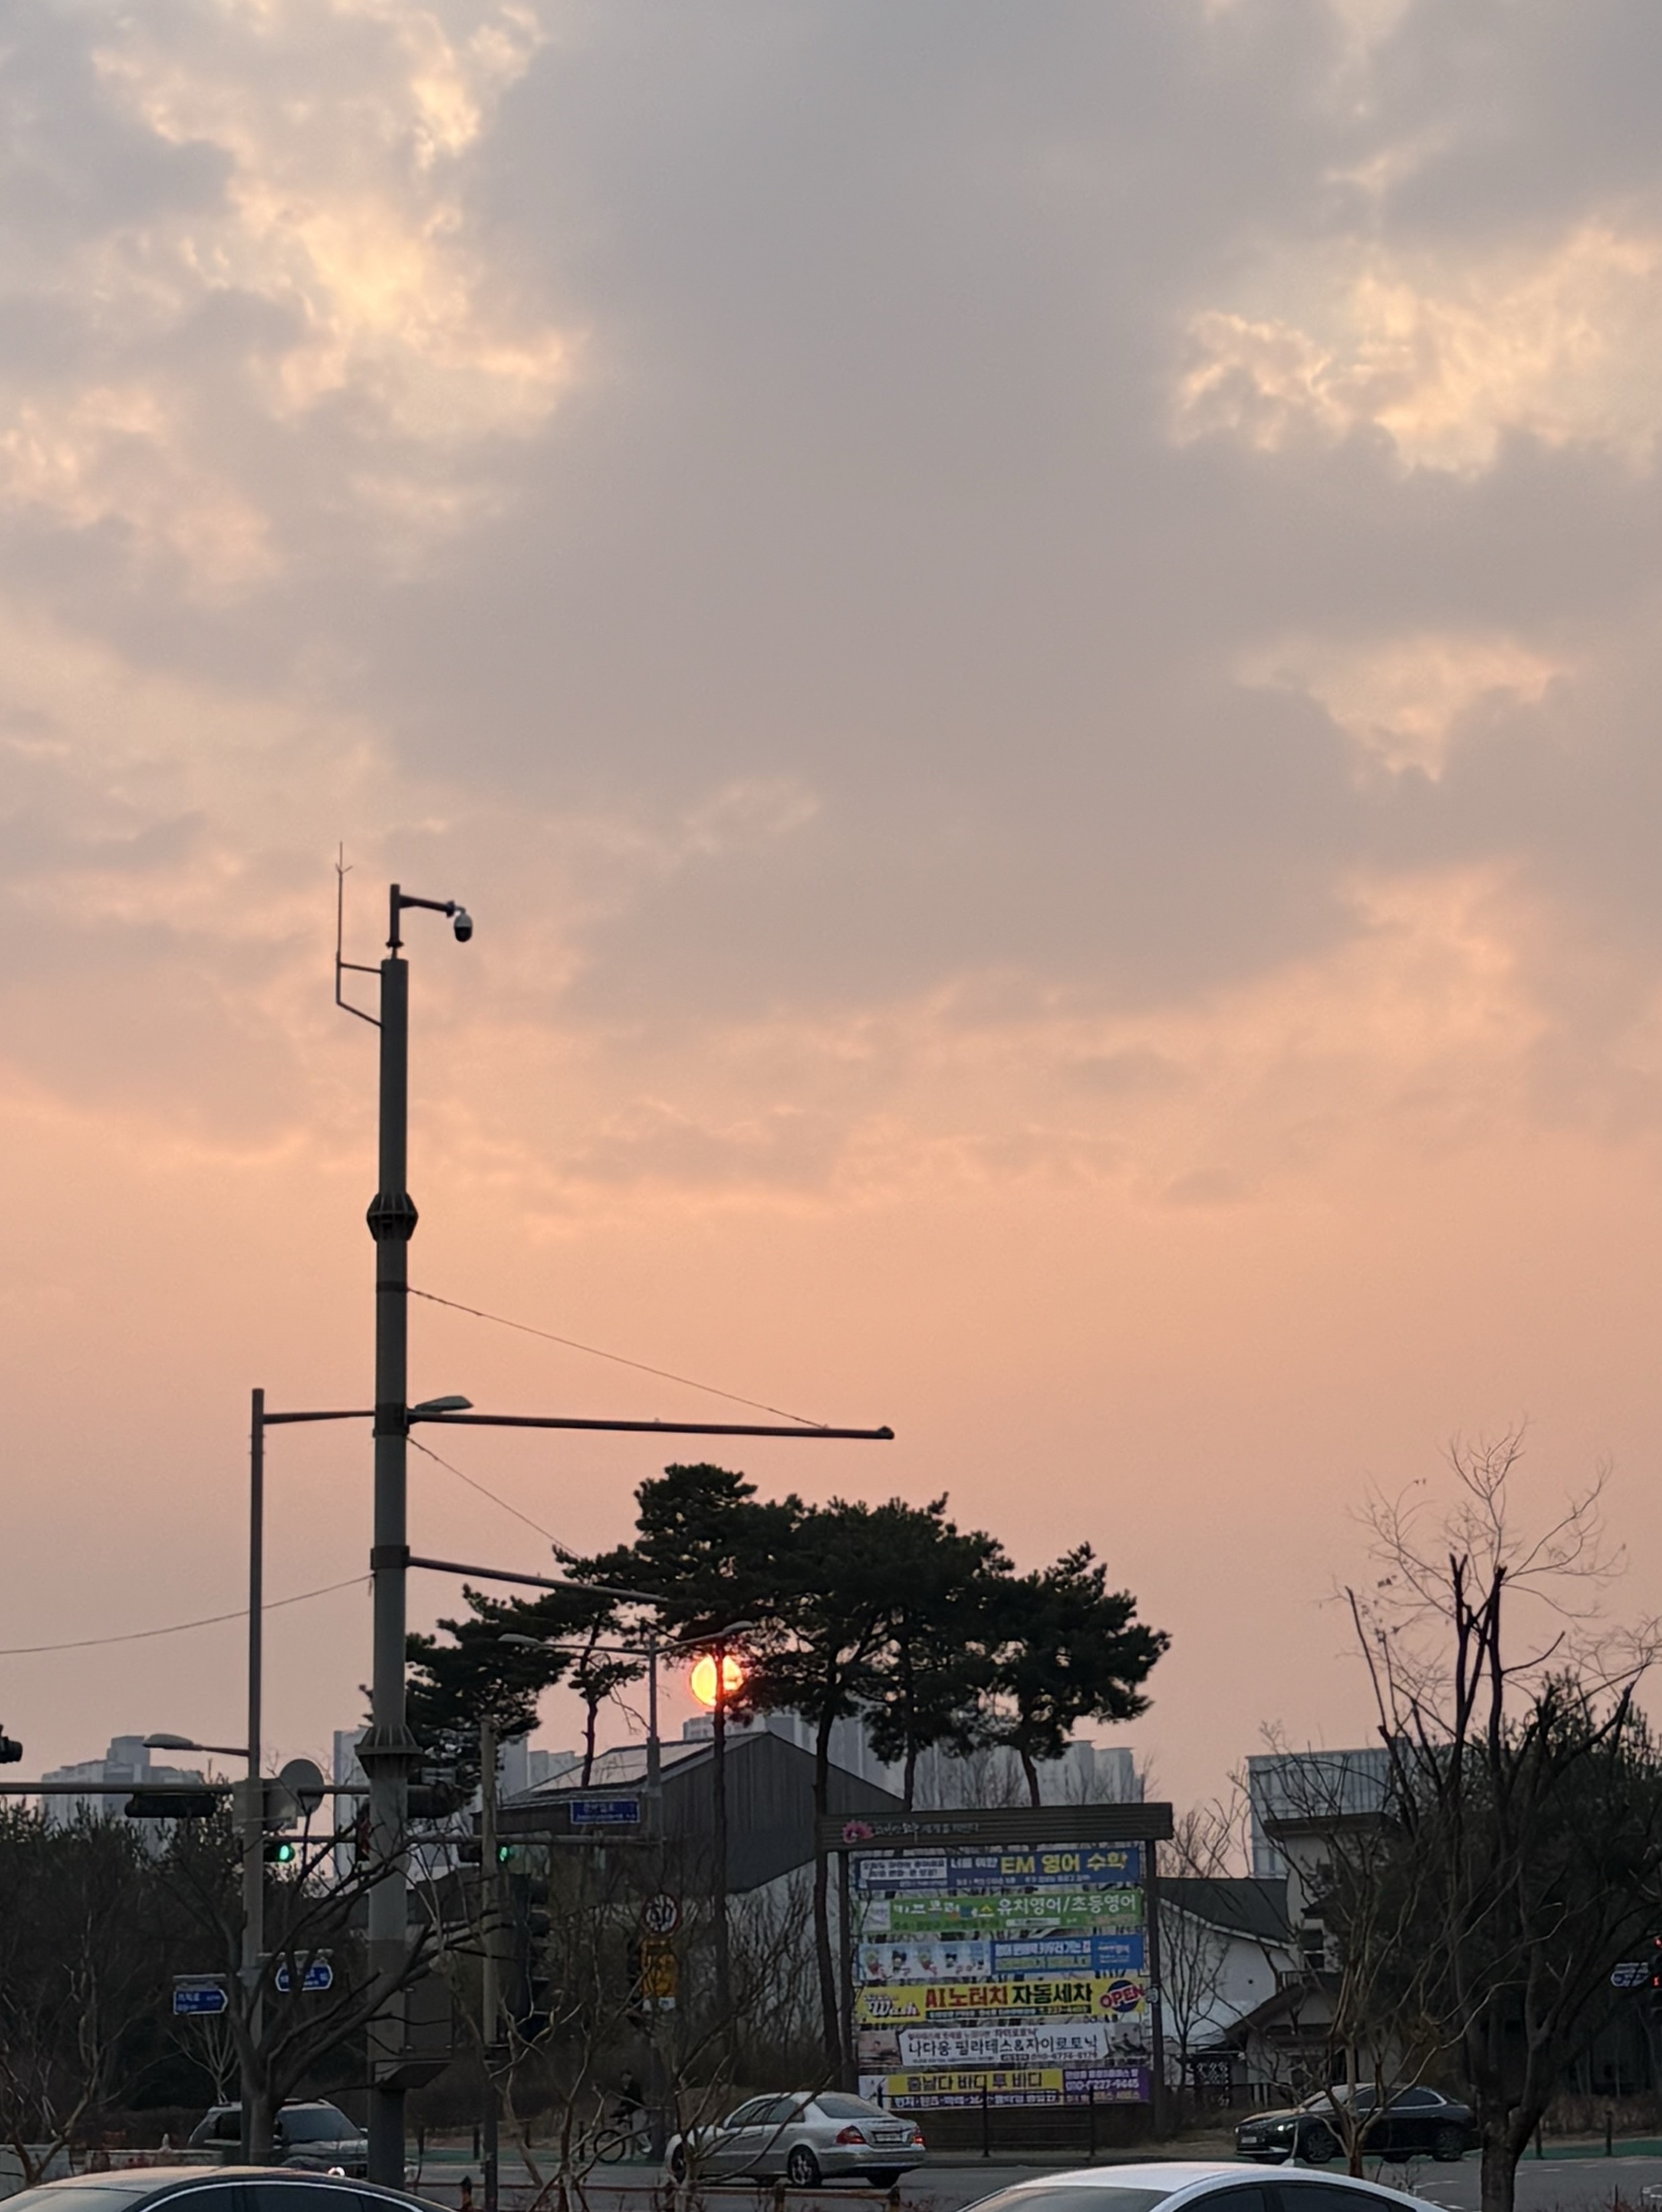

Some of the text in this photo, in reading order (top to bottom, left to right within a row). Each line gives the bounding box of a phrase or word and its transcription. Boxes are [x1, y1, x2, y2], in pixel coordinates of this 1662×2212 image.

[1001, 1856, 1035, 1874] EM
[1042, 1853, 1081, 1873] 영어
[1087, 1851, 1128, 1871] 수학
[997, 1894, 1135, 1916] 유치영어/초등영어
[1012, 1983, 1092, 2005] 자동세차
[1100, 1984, 1145, 2008] OPEN
